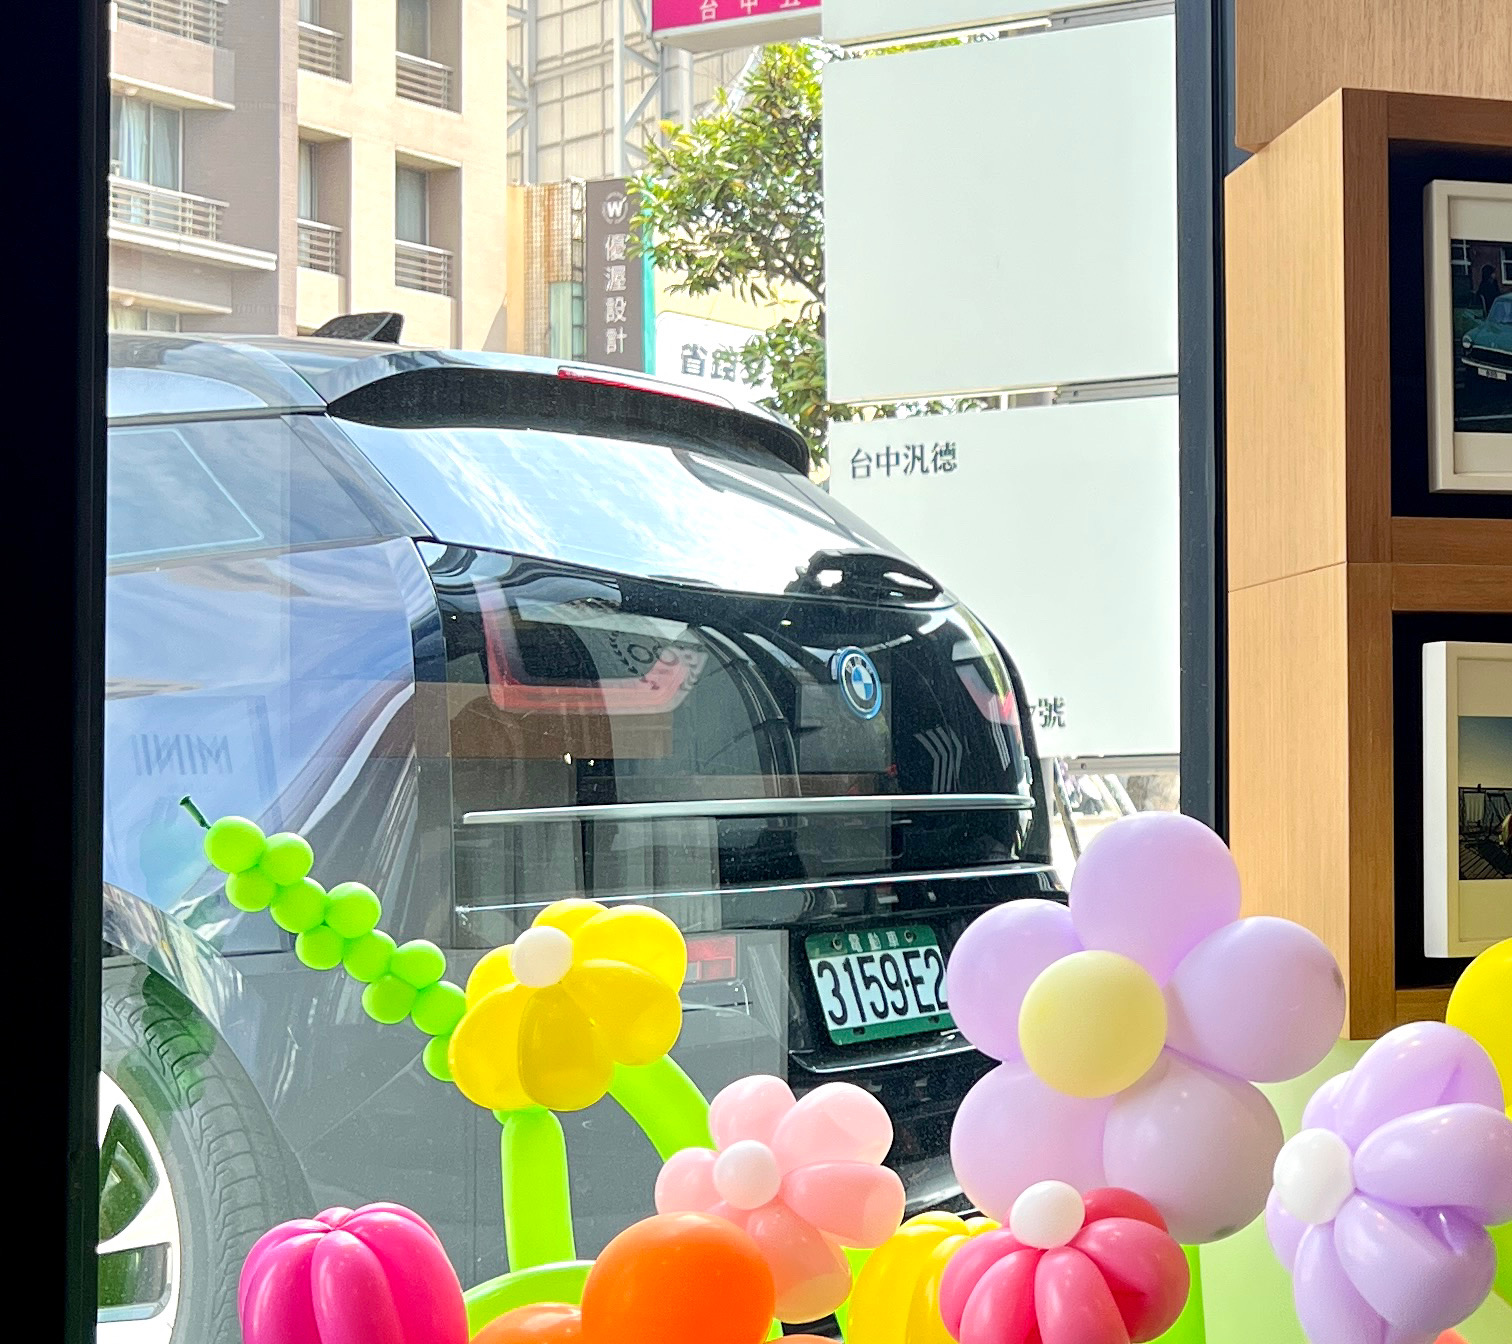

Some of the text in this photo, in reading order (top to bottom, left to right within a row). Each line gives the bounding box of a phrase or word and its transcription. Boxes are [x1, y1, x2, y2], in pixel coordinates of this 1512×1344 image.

[603, 232, 628, 355] 優渥設計
[851, 441, 958, 479] 台中汎德
